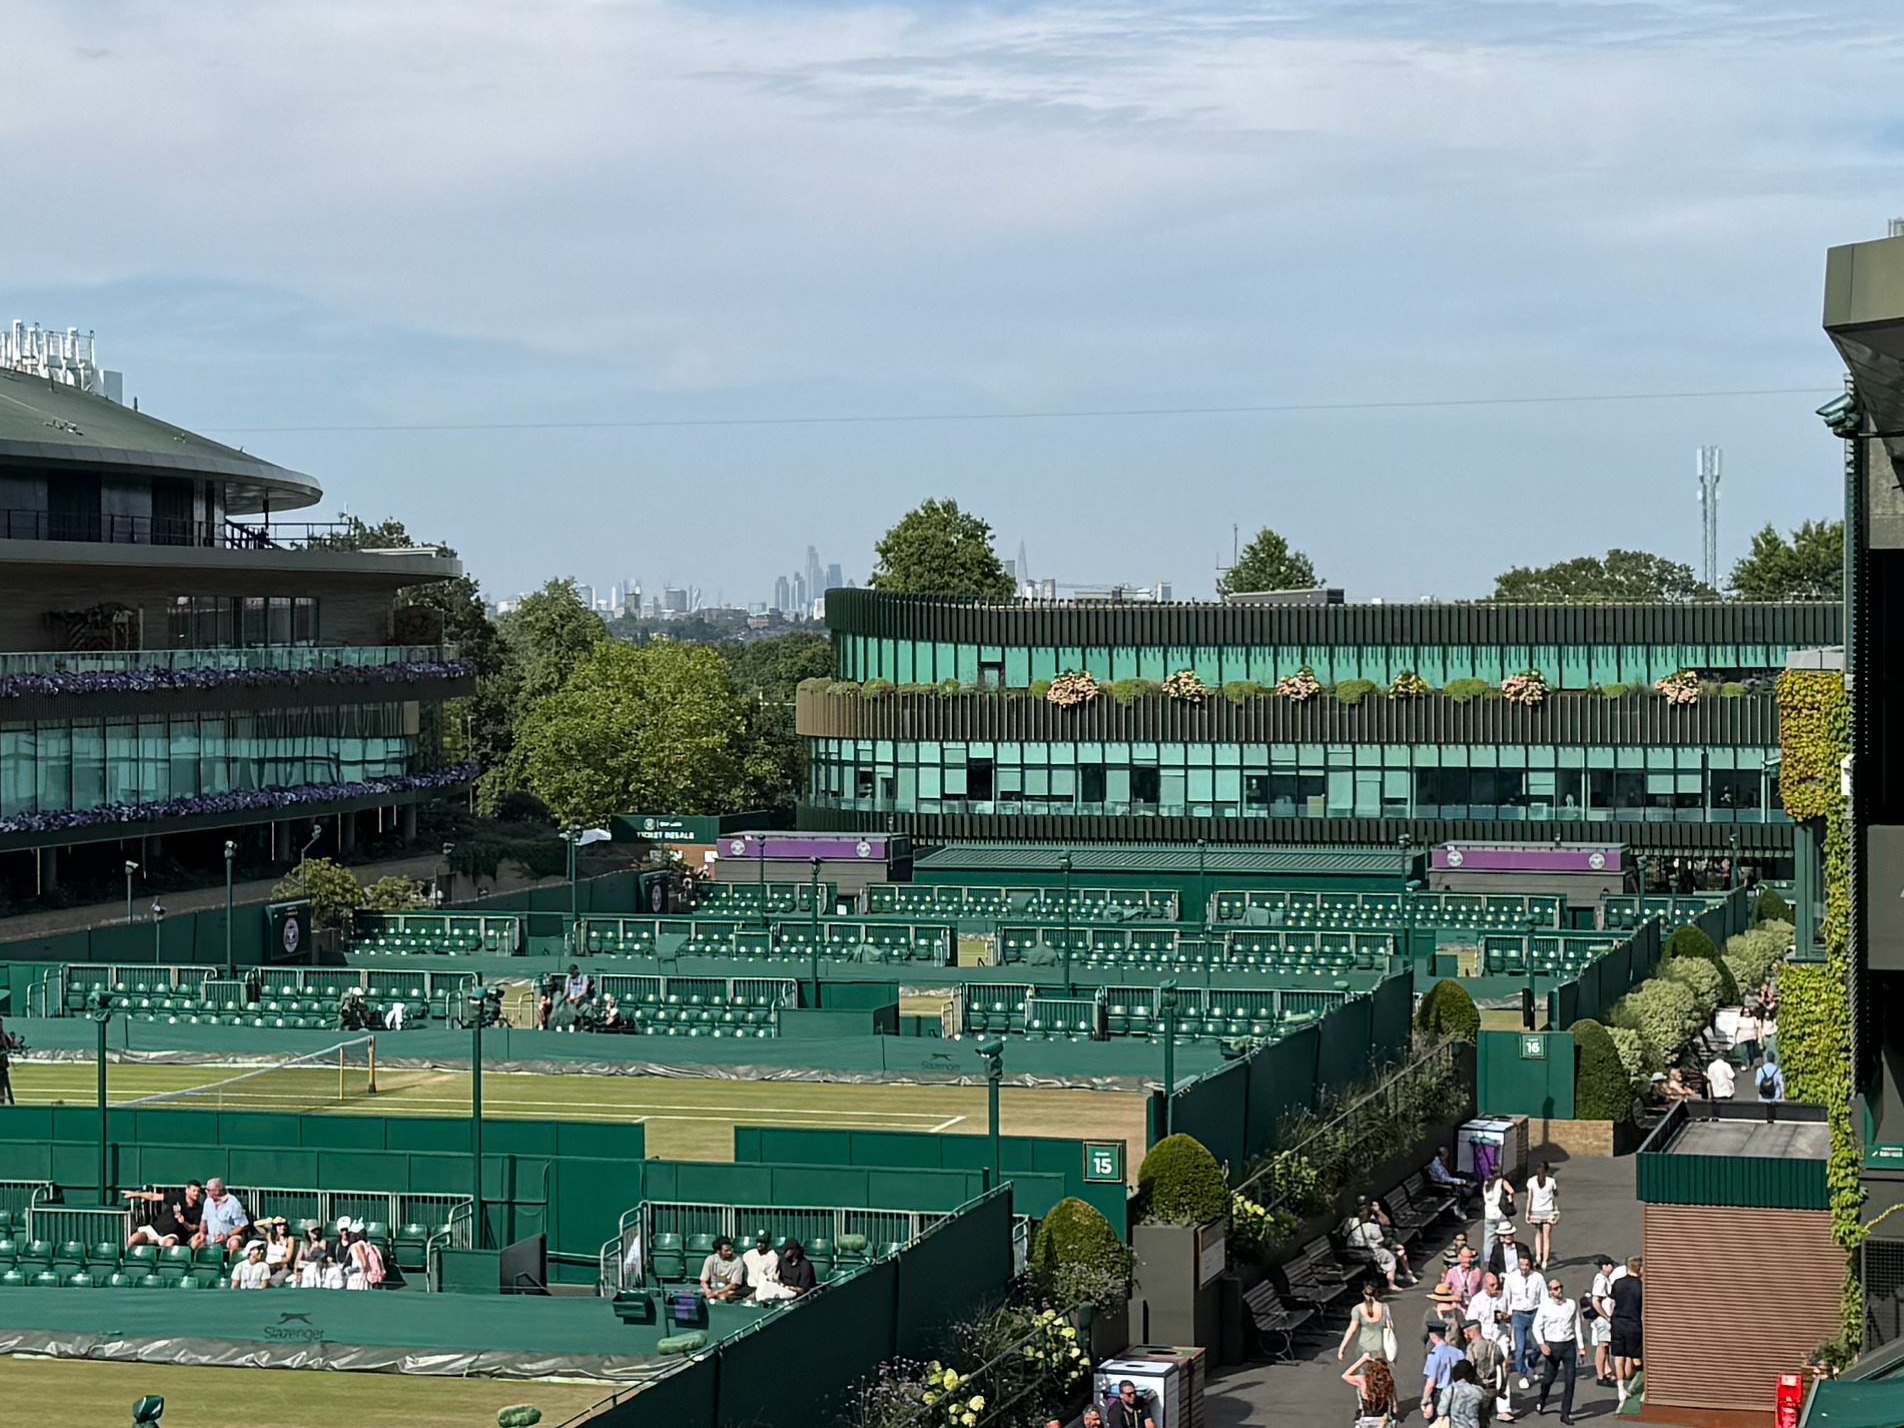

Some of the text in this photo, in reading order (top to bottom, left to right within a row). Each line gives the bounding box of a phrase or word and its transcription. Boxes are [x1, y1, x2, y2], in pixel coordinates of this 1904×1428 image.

[664, 832, 694, 840] RESALE
[1526, 1042, 1540, 1053] 16
[1093, 1157, 1112, 1174] 15
[263, 1326, 324, 1343] Slazenger
